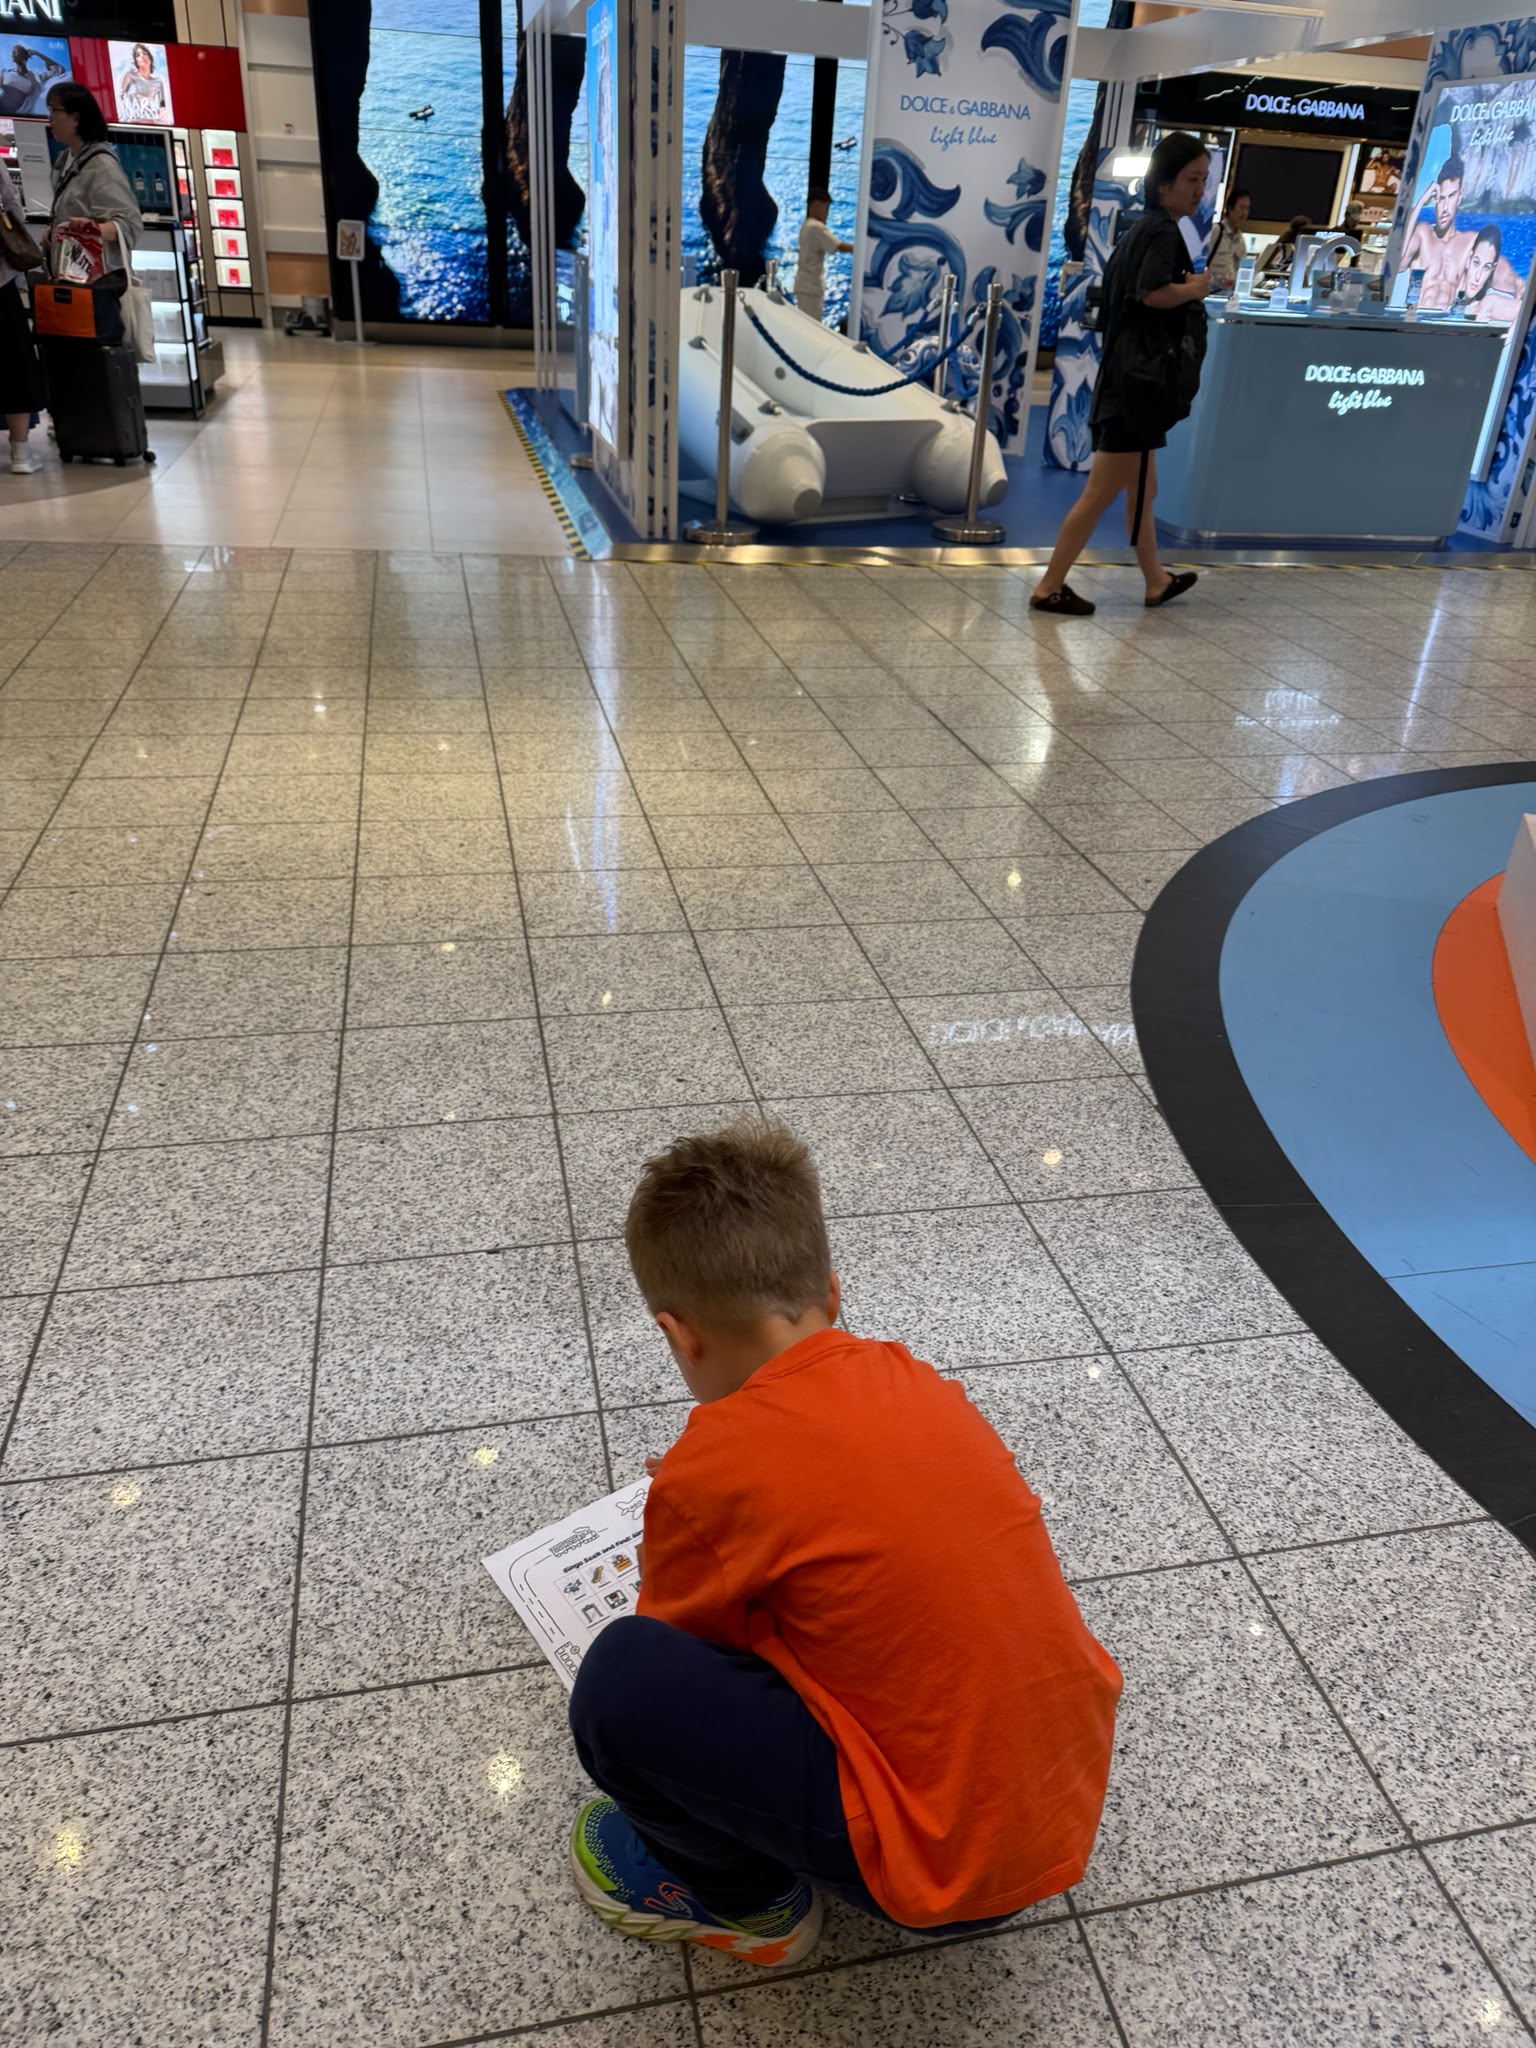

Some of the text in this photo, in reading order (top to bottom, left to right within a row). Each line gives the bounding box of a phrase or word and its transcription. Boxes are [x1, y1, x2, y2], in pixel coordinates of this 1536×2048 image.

[0, 0, 63, 19] ANI
[929, 125, 998, 151] light blue
[1327, 388, 1393, 416] light blue
